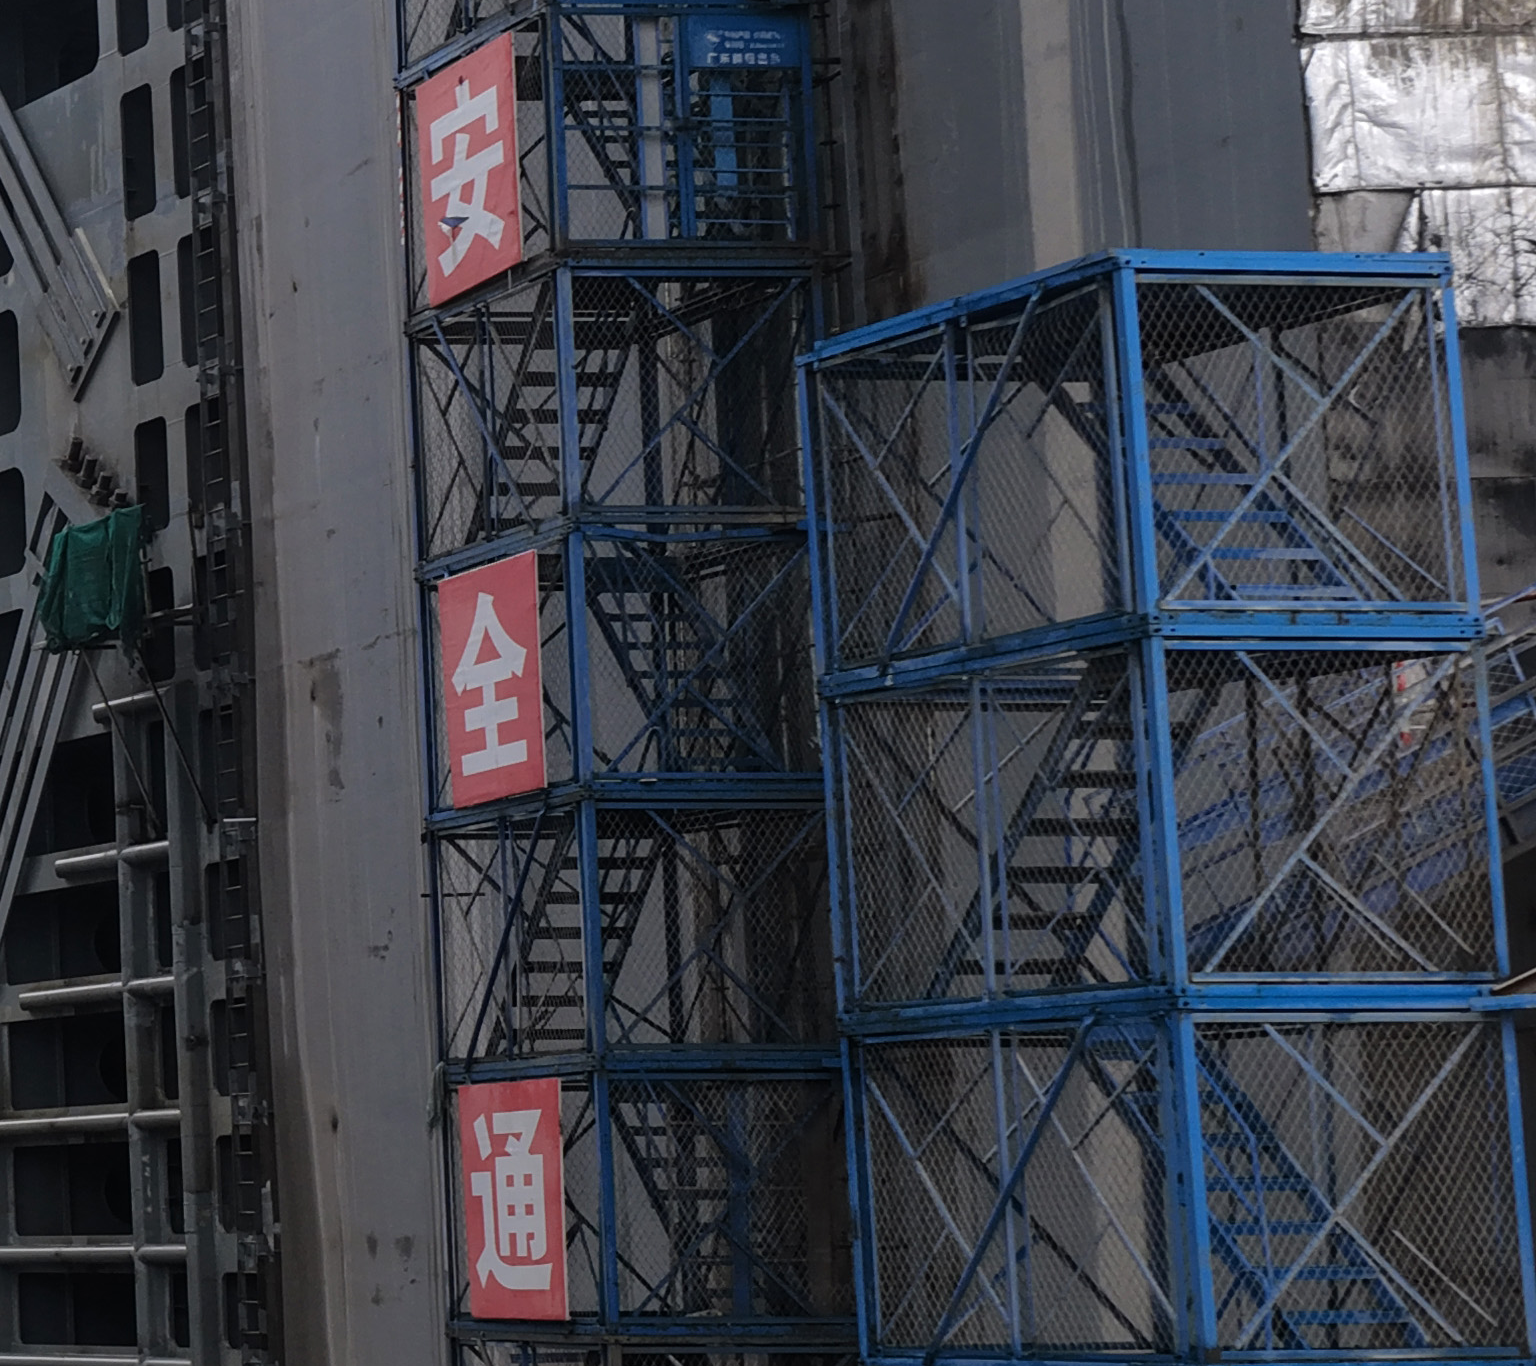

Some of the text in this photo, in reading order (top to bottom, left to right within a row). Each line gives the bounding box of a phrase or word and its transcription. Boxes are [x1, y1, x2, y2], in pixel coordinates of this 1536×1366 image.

[431, 80, 507, 277] 安
[451, 592, 530, 777] 全
[471, 1109, 552, 1290] 通
